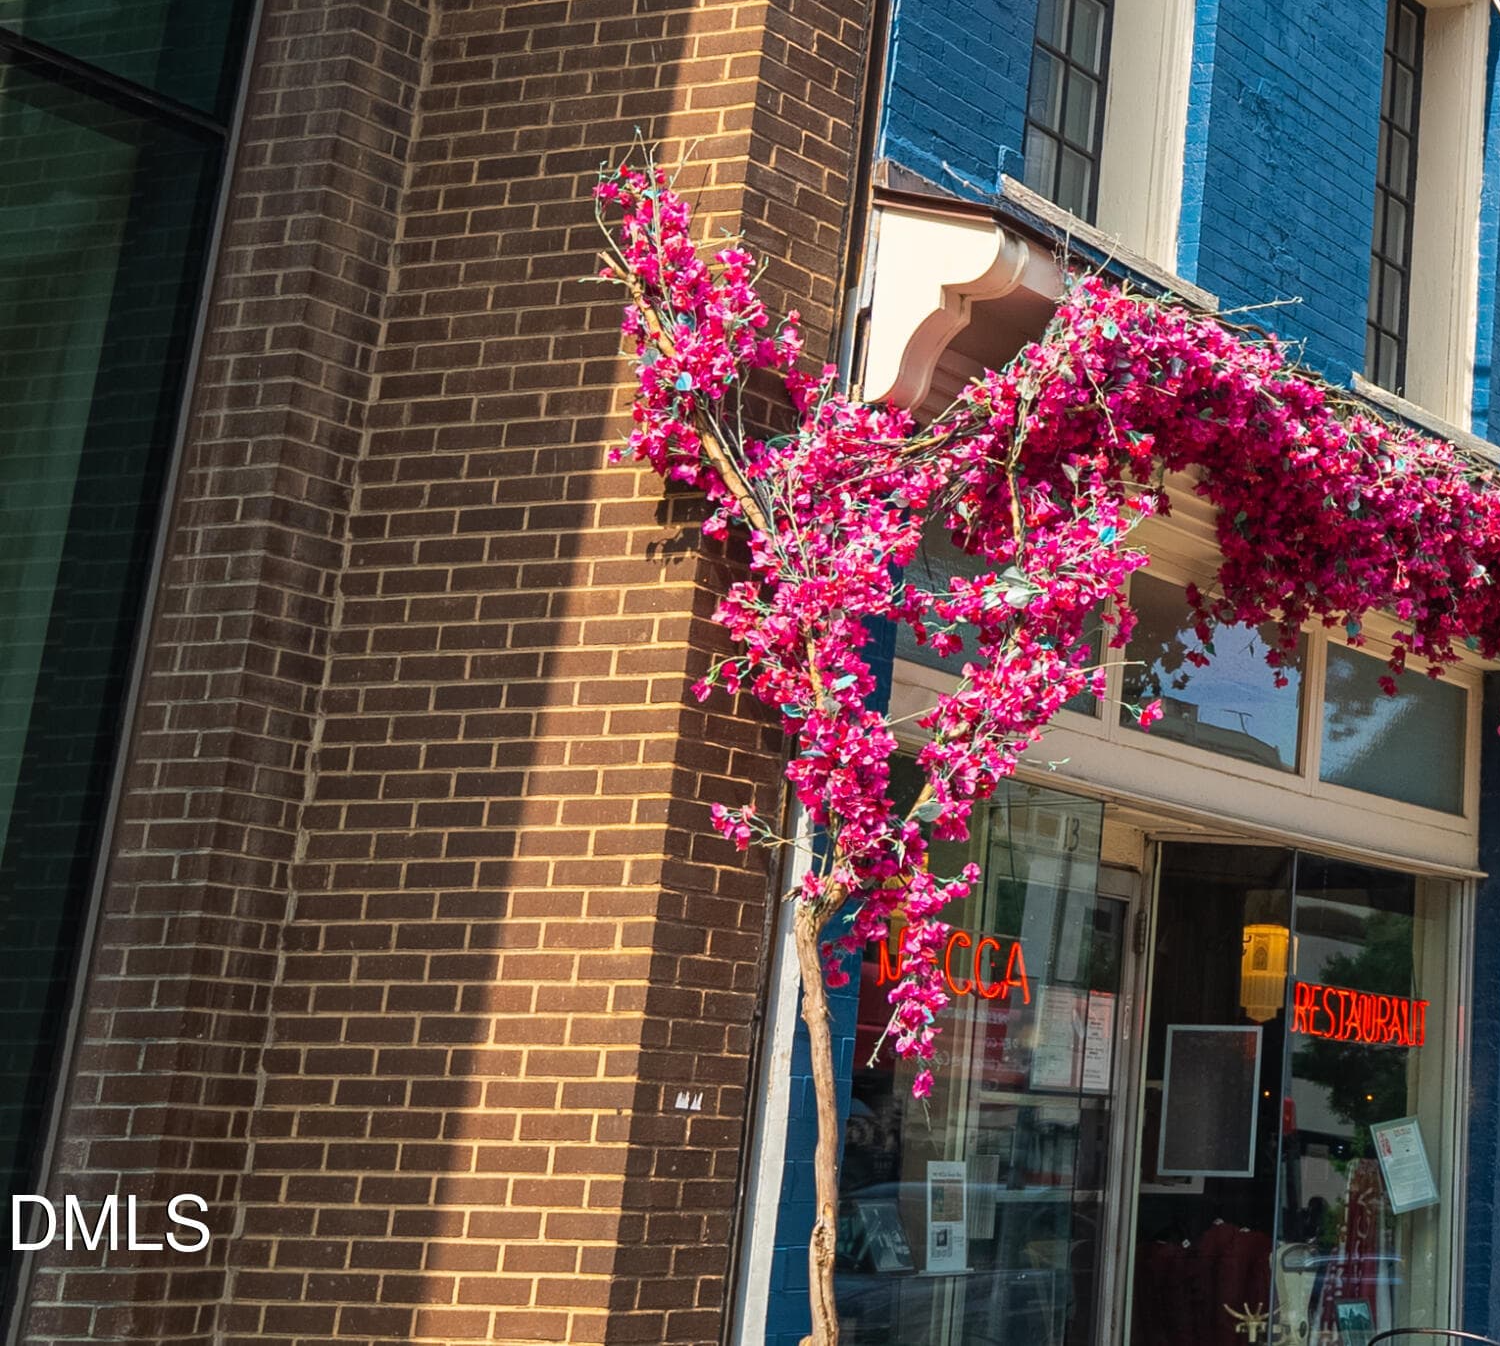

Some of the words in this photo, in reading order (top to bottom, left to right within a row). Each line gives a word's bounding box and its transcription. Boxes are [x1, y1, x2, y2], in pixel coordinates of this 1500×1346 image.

[1063, 816, 1080, 852] 13
[876, 926, 1031, 1004] MCCA
[1290, 981, 1430, 1046] RESTAURANT
